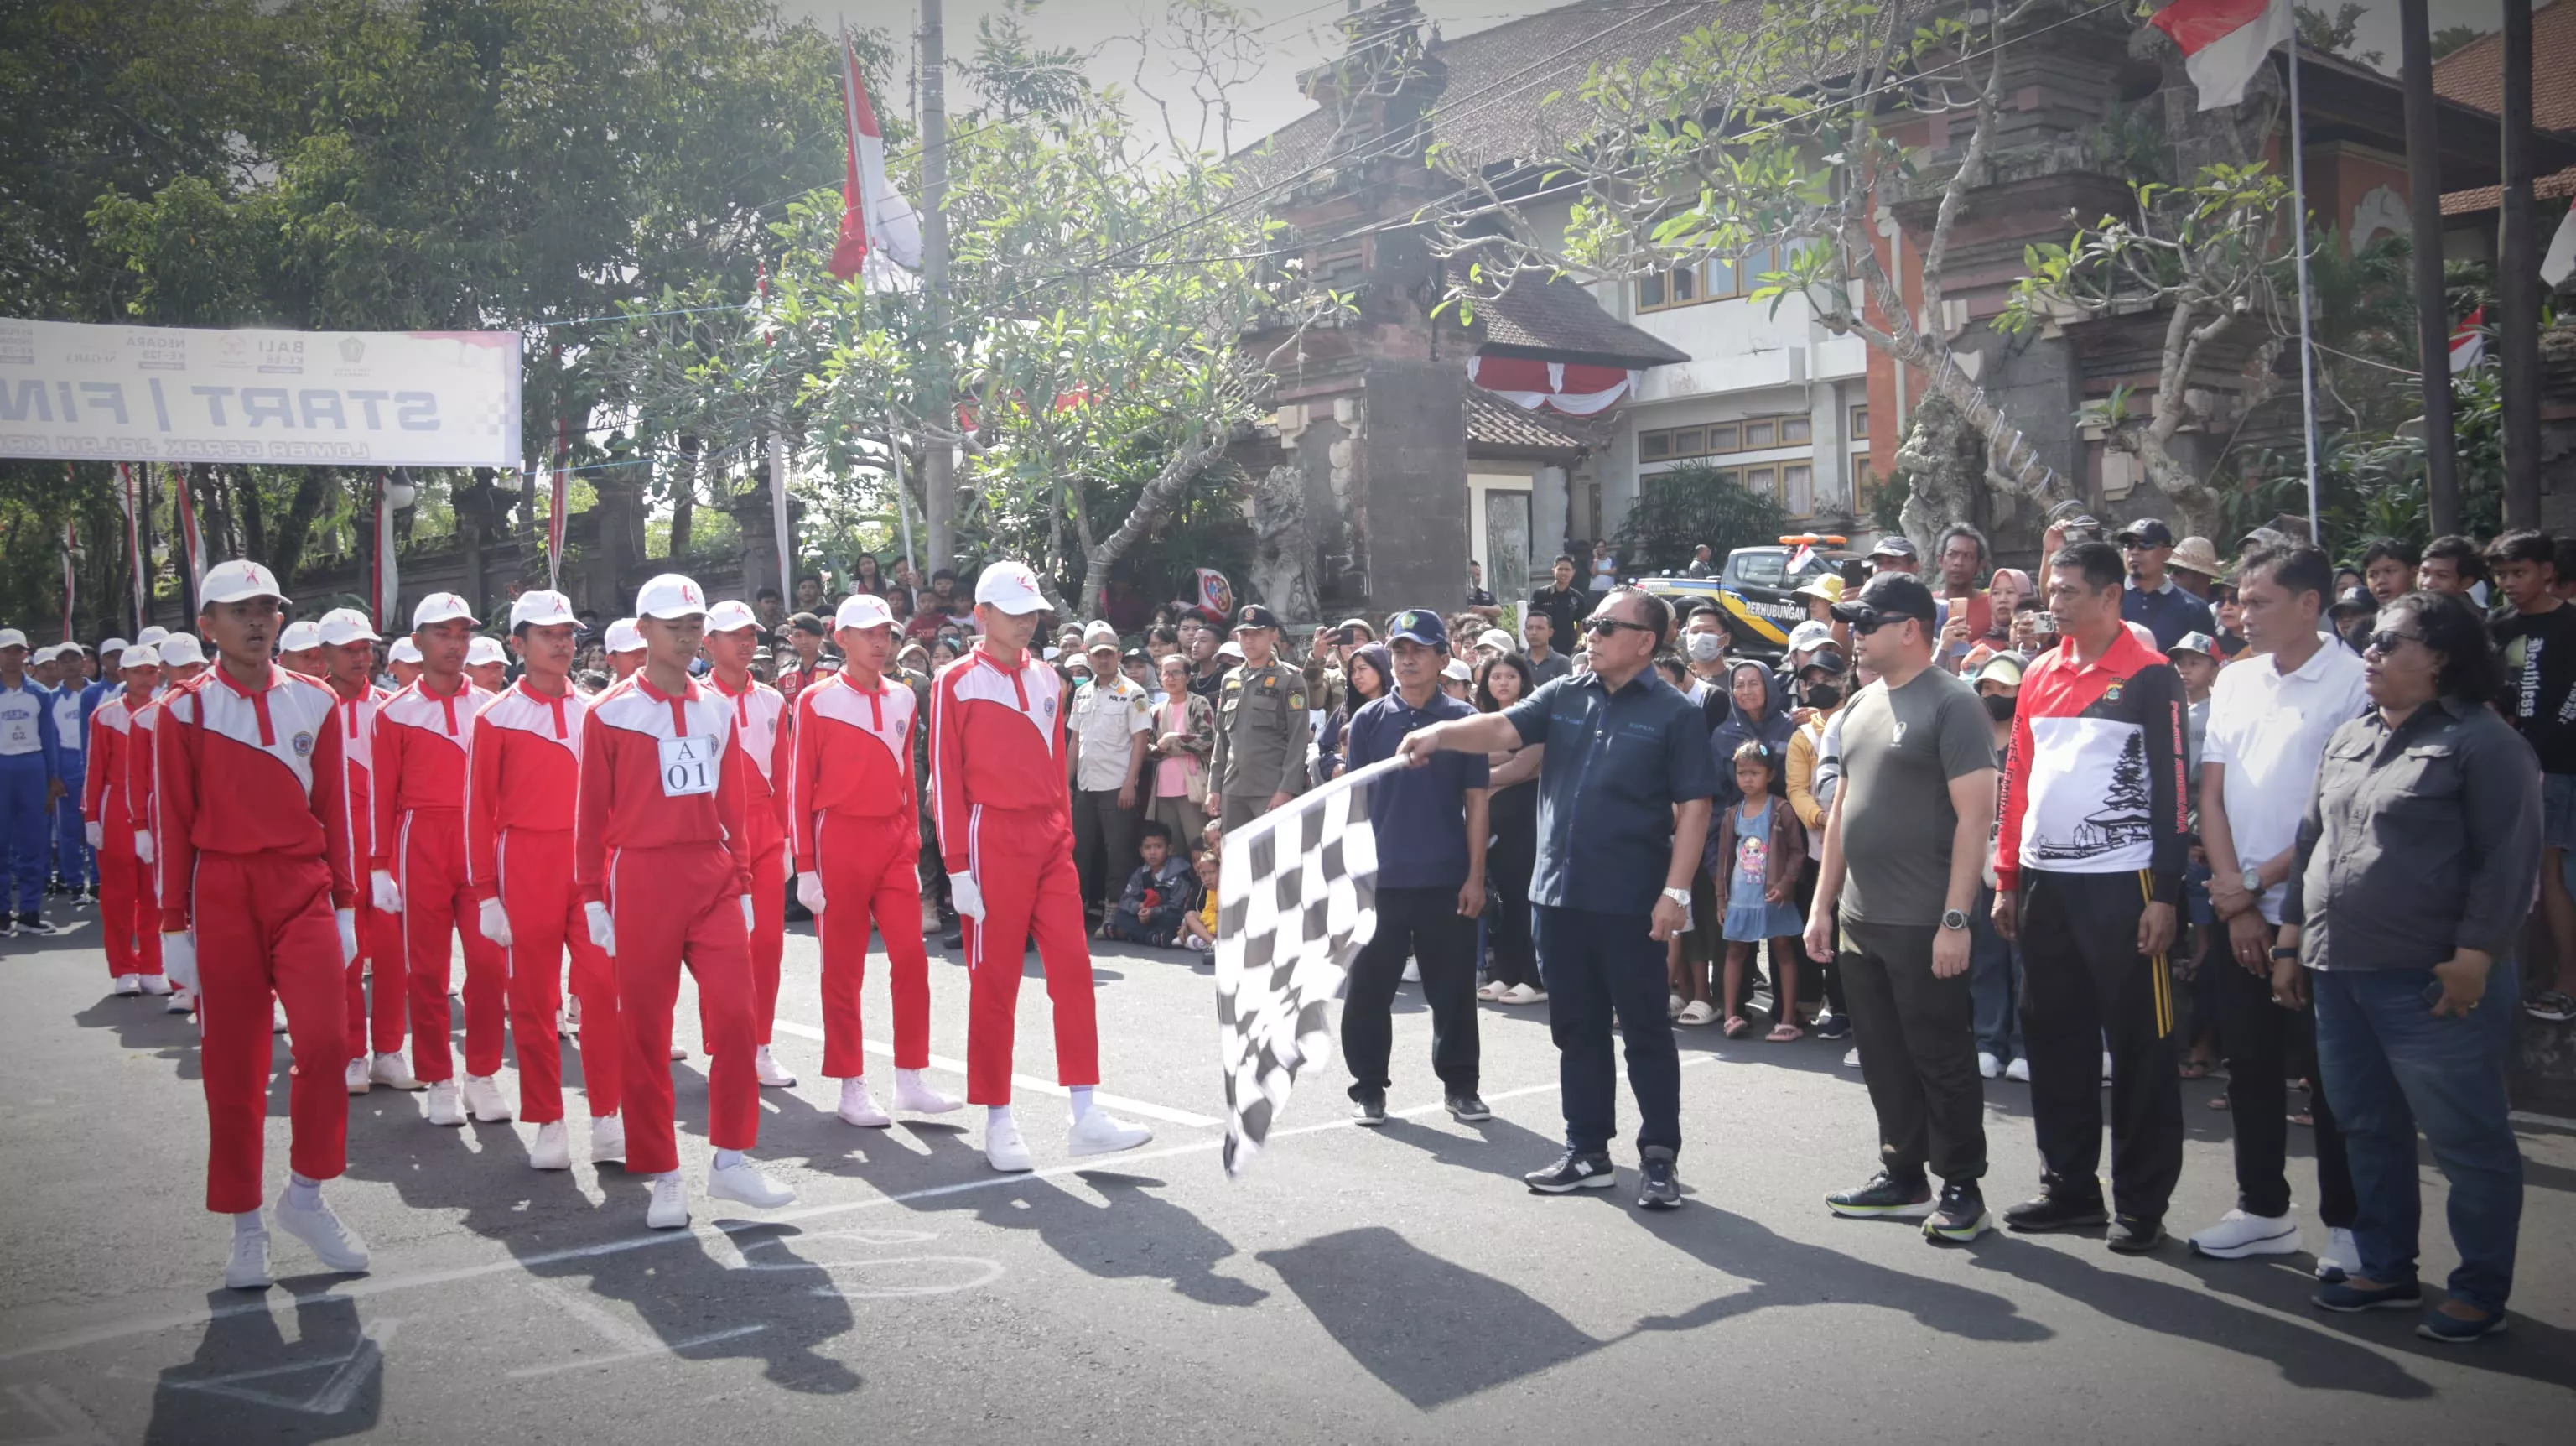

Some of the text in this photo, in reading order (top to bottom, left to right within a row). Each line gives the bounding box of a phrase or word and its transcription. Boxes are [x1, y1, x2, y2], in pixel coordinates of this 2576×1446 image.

[1744, 601, 1807, 622] PERHUBUNGAN
[677, 741, 696, 761] A
[668, 762, 709, 789] 01
